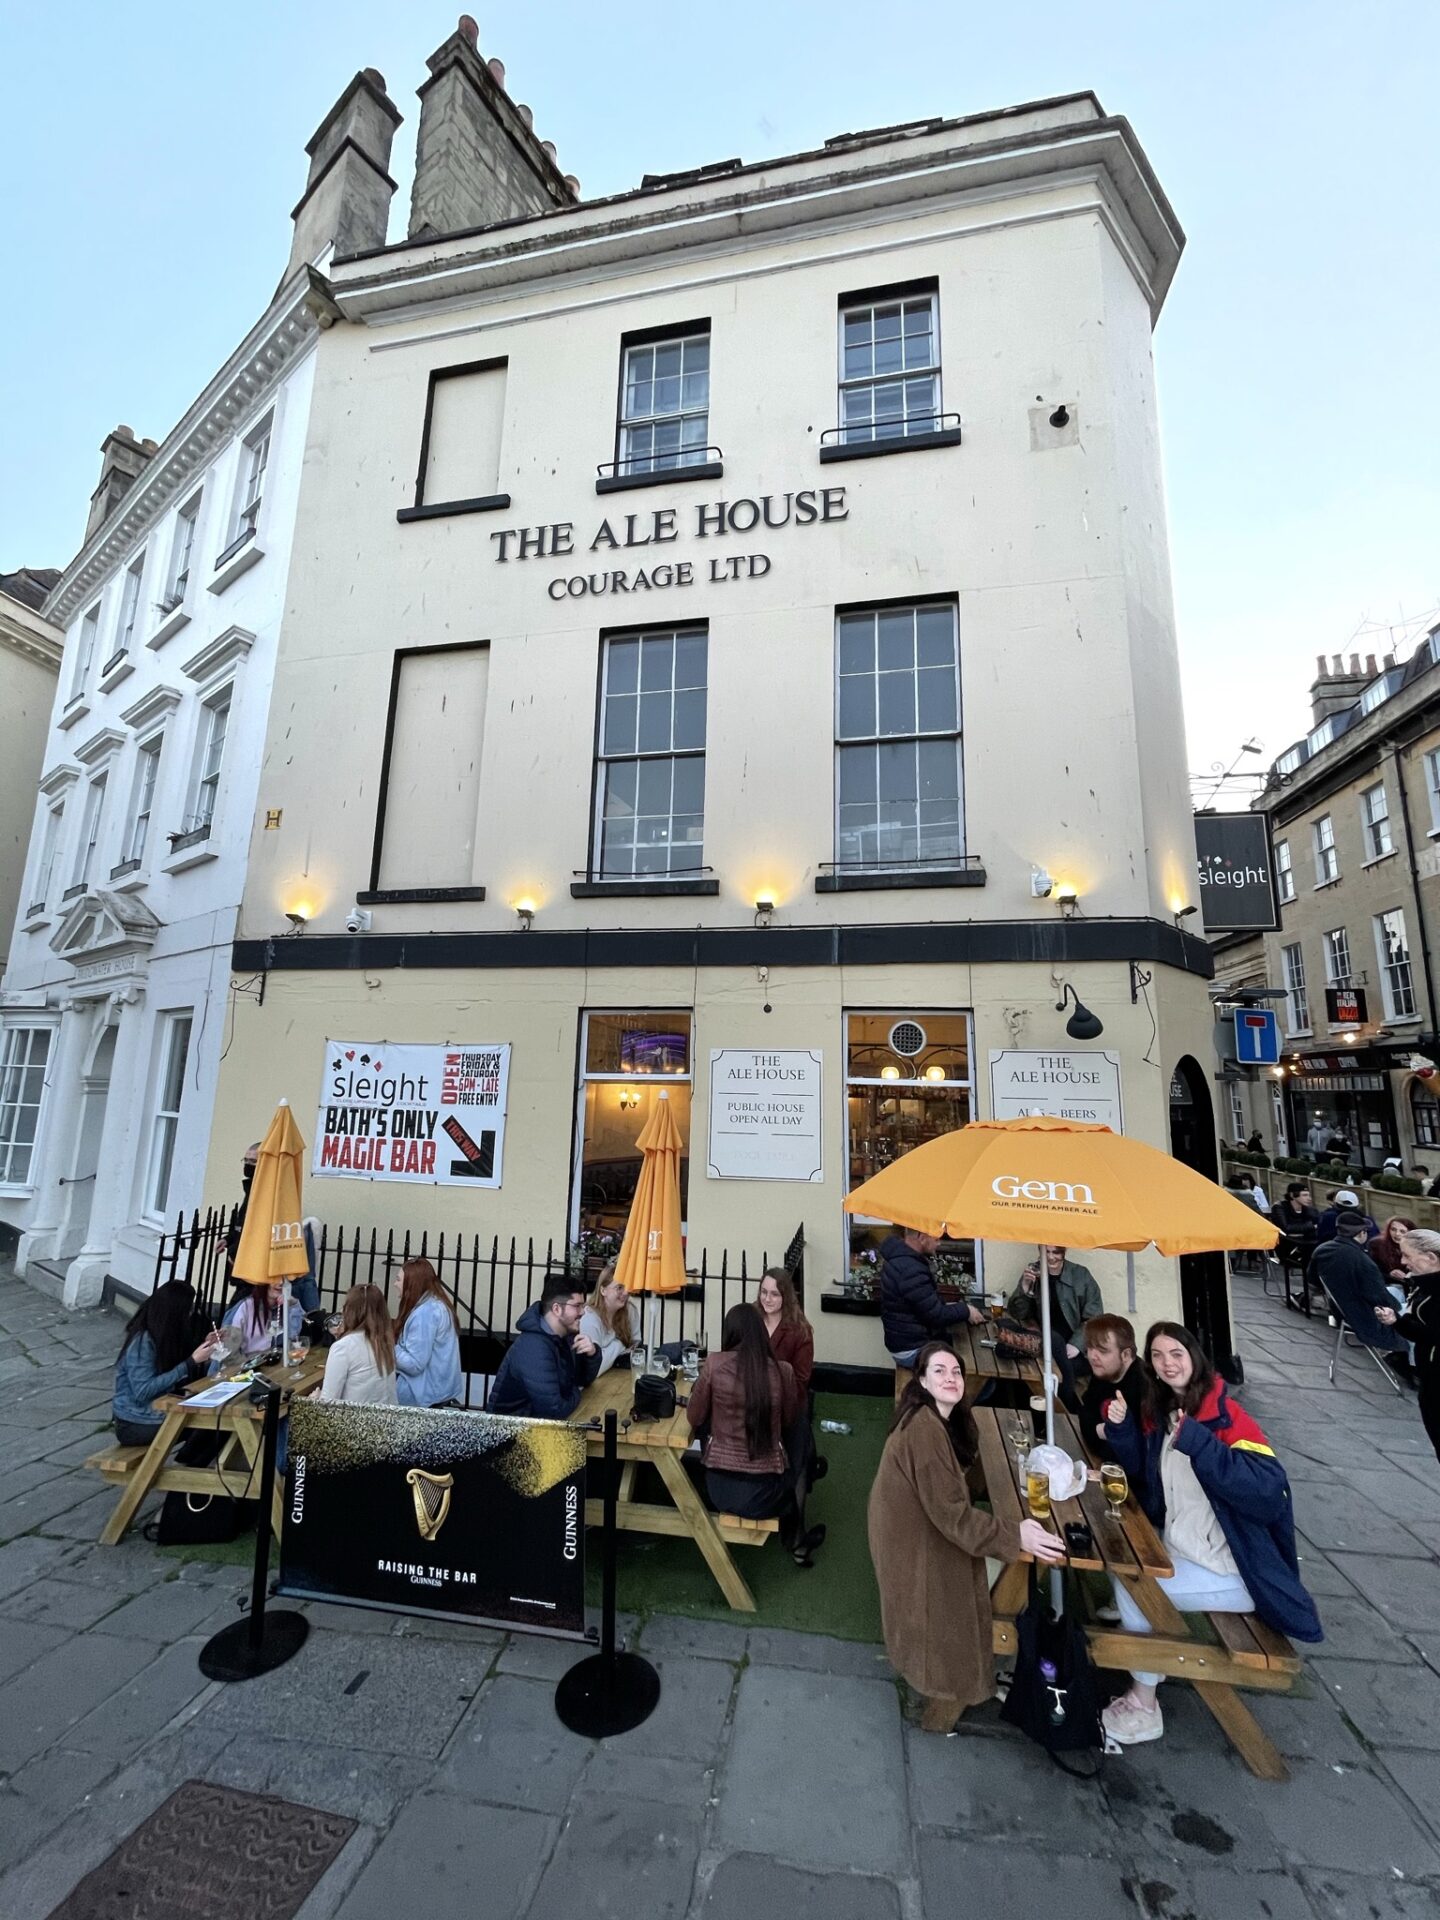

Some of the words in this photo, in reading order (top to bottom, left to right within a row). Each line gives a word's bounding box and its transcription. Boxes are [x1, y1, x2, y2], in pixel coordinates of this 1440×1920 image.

[490, 522, 574, 562] THE
[589, 509, 678, 550] ALE
[694, 487, 850, 538] HOUSE
[548, 562, 694, 600] COURAGE
[708, 554, 771, 582] LTD
[1198, 866, 1268, 888] sleight
[461, 1053, 501, 1061] THURSDAY
[752, 1055, 780, 1066] THE
[1037, 1057, 1071, 1069] THE
[461, 1061, 492, 1069] FRIDAY
[441, 1054, 460, 1104] OPEN
[728, 1068, 752, 1079] ALE
[756, 1069, 805, 1080] HOUSE
[1010, 1071, 1038, 1083] ALE
[1043, 1071, 1100, 1084] HOUSE
[332, 1071, 428, 1107] sleight
[459, 1078, 475, 1091] 6PM
[482, 1078, 499, 1092] LATE
[458, 1093, 475, 1105] FREE
[476, 1093, 499, 1106] ENTRY
[728, 1102, 765, 1111] PUBLIC
[768, 1103, 805, 1112] HOUSE
[730, 1115, 758, 1123] OPEN
[761, 1116, 780, 1124] ALL
[782, 1116, 802, 1125] DAY
[1060, 1109, 1096, 1119] BEERS
[325, 1106, 388, 1137] BATH'S
[391, 1109, 438, 1139] ONLY
[320, 1135, 387, 1171] MAGIC
[390, 1139, 436, 1174] BAR
[991, 1175, 1097, 1204] Gem
[1011, 1202, 1049, 1210] PREMIUM
[291, 1455, 306, 1524] GUINNESS
[563, 1485, 577, 1560] GUINNESS
[378, 1559, 424, 1576] RAISING
[428, 1566, 450, 1580] THE
[454, 1570, 477, 1584] BAR
[410, 1575, 442, 1587] GUINNESS
